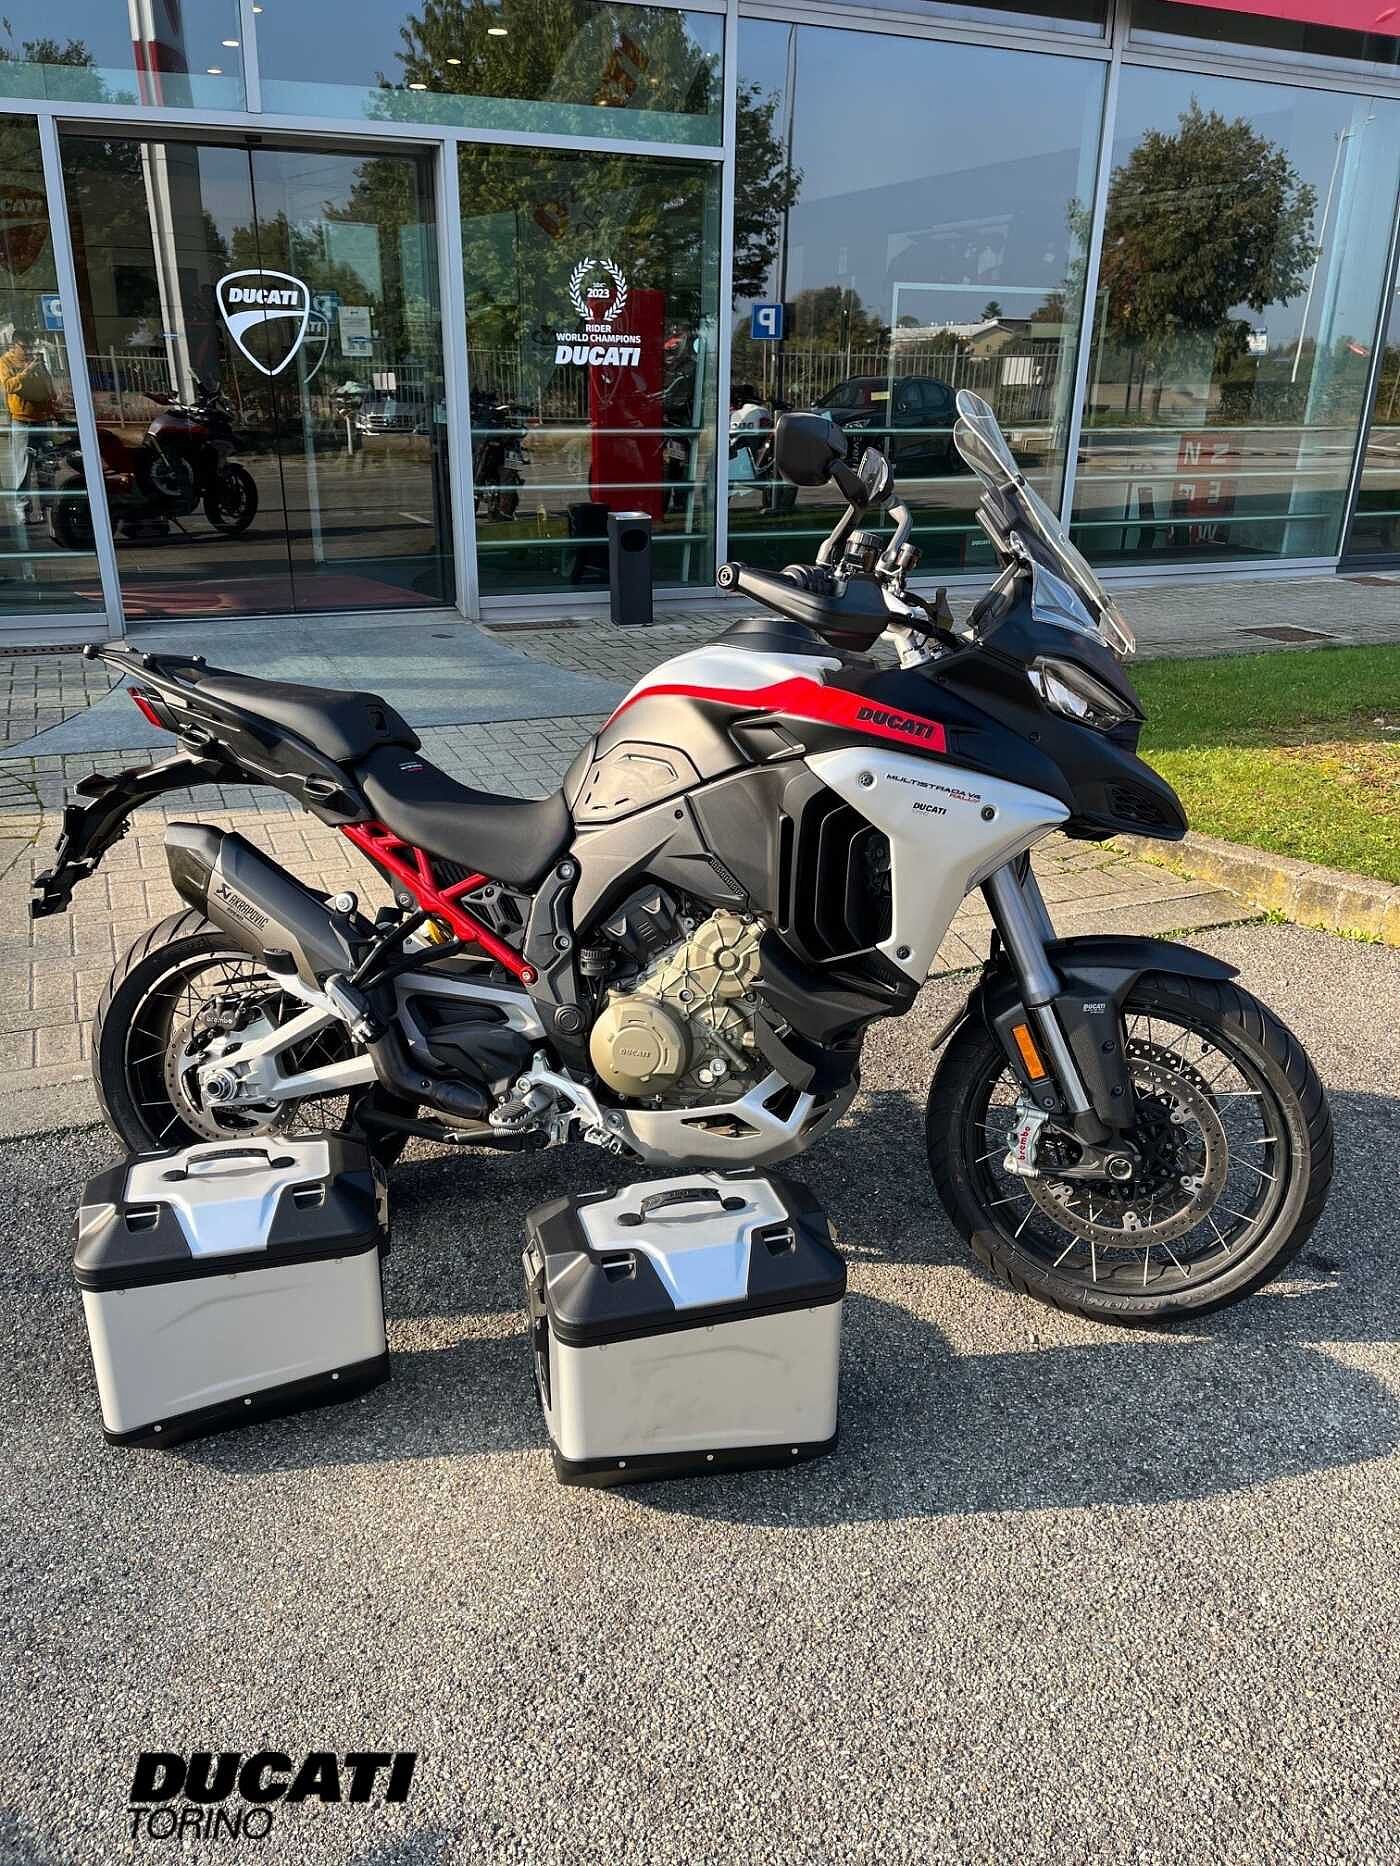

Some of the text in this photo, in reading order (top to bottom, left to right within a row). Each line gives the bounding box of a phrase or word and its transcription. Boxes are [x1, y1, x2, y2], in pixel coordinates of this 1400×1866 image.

[228, 287, 299, 306] DUCATI
[586, 288, 611, 298] 2023
[556, 332, 642, 344] WORLD CHAMPIONS
[585, 324, 613, 333] RIDER
[554, 345, 641, 366] DUCATI
[856, 706, 935, 740] DUCATI
[885, 773, 966, 797] MULTISTRADA
[912, 801, 948, 816] DUCATI
[1017, 1126, 1032, 1161] brembo
